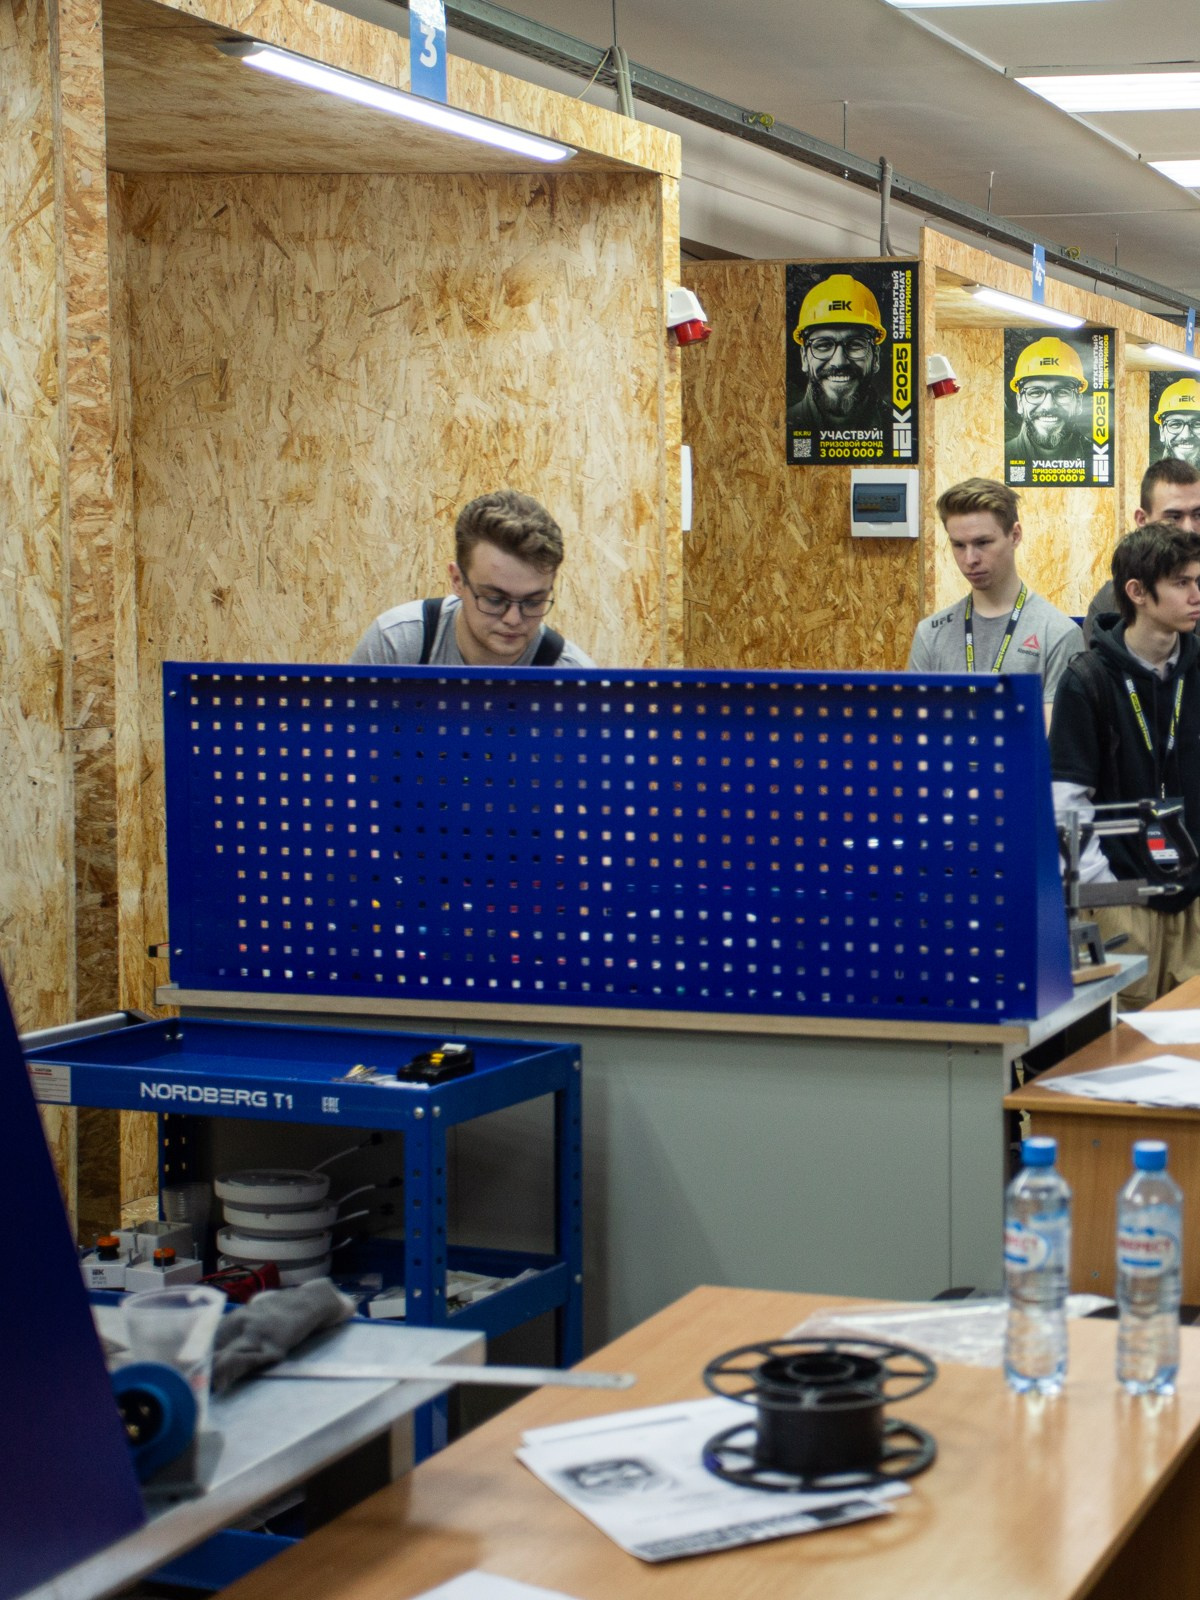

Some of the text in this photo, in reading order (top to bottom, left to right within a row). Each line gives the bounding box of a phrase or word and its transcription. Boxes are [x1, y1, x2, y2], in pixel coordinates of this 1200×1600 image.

[420, 21, 438, 68] 3
[828, 300, 853, 311] IEK
[891, 270, 899, 340] ОТКРЫТЫЙ
[1187, 321, 1193, 342] 5
[1040, 357, 1059, 366] IEK
[893, 347, 912, 458] IEK 2025
[1178, 395, 1195, 403] IEK
[820, 428, 883, 440] УЧАСТВУЙ!
[1093, 395, 1109, 482] IEK 2025
[820, 440, 860, 448] ПРИЗОВОЙ
[820, 448, 827, 457] 3
[828, 448, 850, 457] 000
[852, 448, 875, 457] 000
[1032, 458, 1086, 468] УЧАСТВУЙ!
[1032, 474, 1038, 482] 3
[1039, 474, 1058, 482] 000
[1059, 474, 1078, 482] 000
[931, 613, 954, 629] UFC
[140, 1081, 293, 1110] NORDBERG T1
